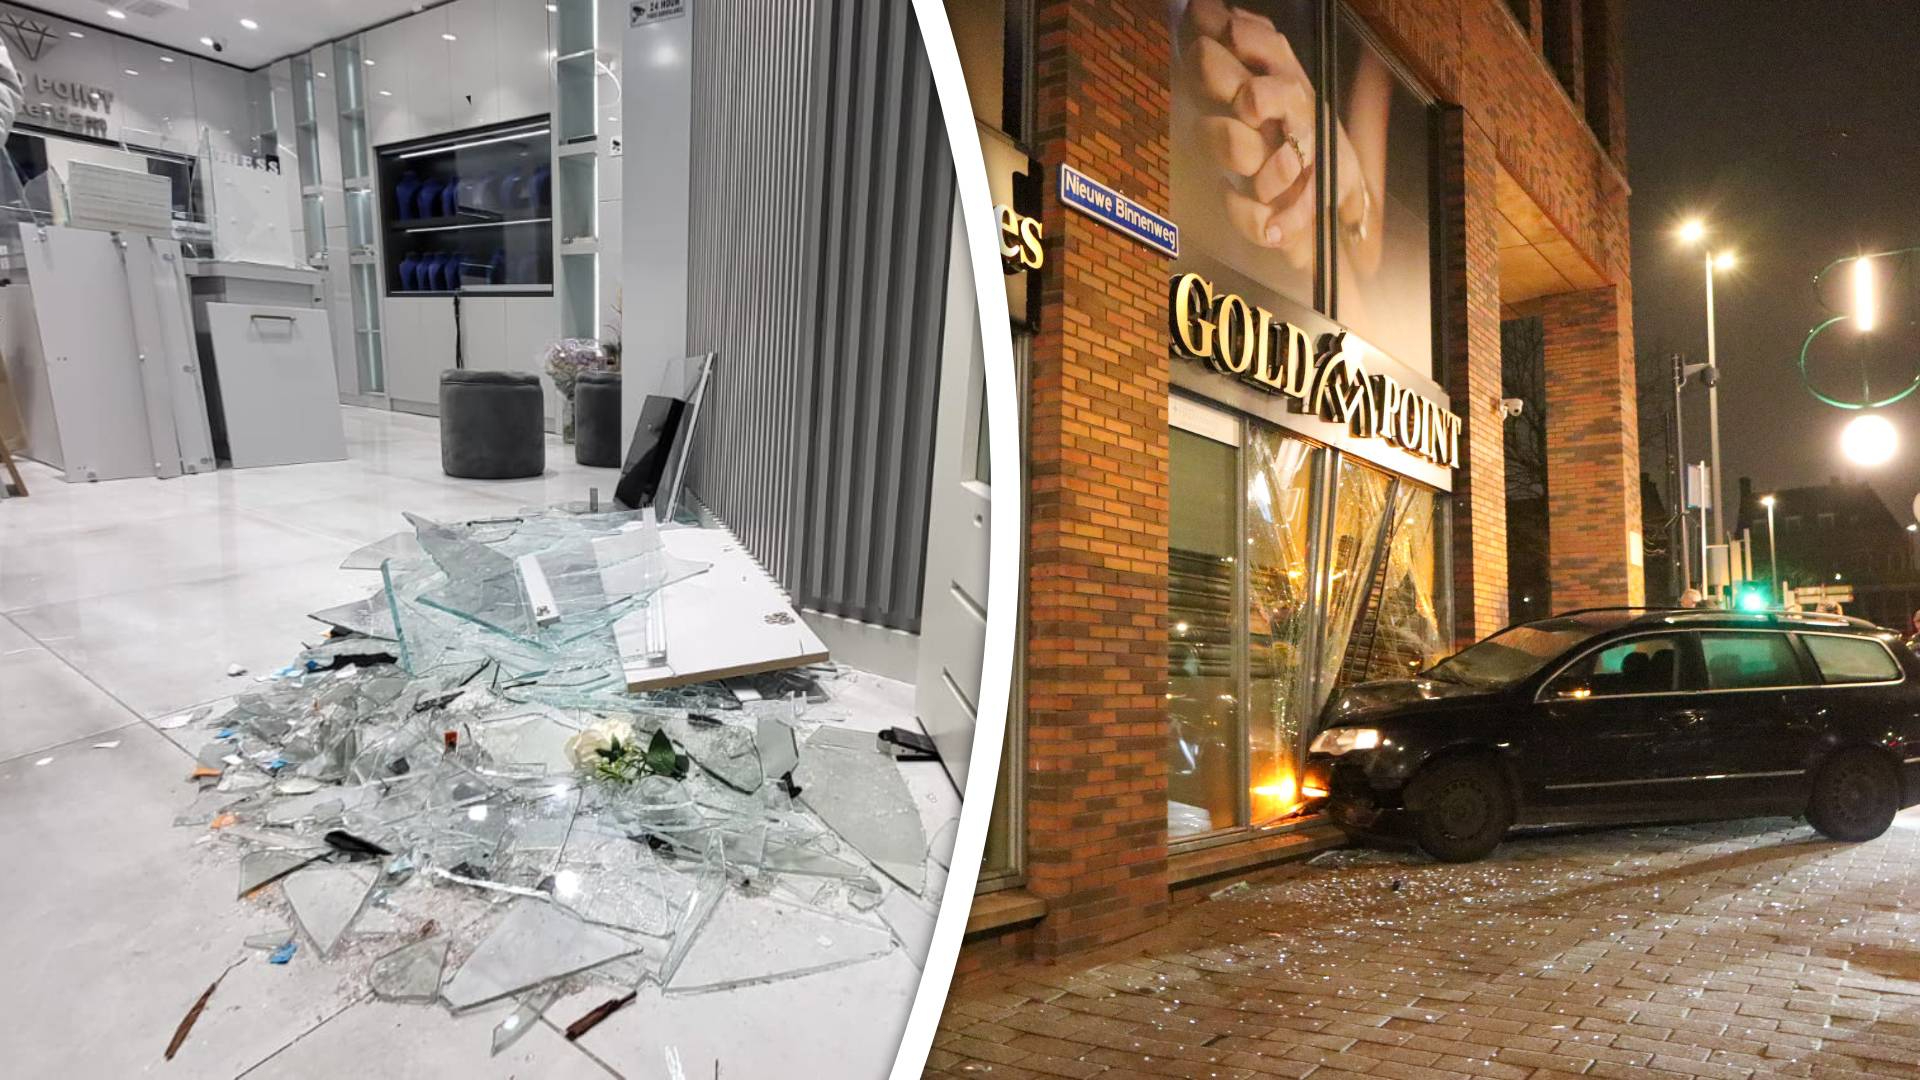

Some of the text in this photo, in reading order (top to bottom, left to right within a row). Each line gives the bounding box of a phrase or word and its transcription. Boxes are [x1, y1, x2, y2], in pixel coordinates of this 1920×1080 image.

[993, 203, 1044, 269] es
[1065, 171, 1176, 250] Nieuwe Binnenweg
[1174, 272, 1462, 469] GOLD POINT
